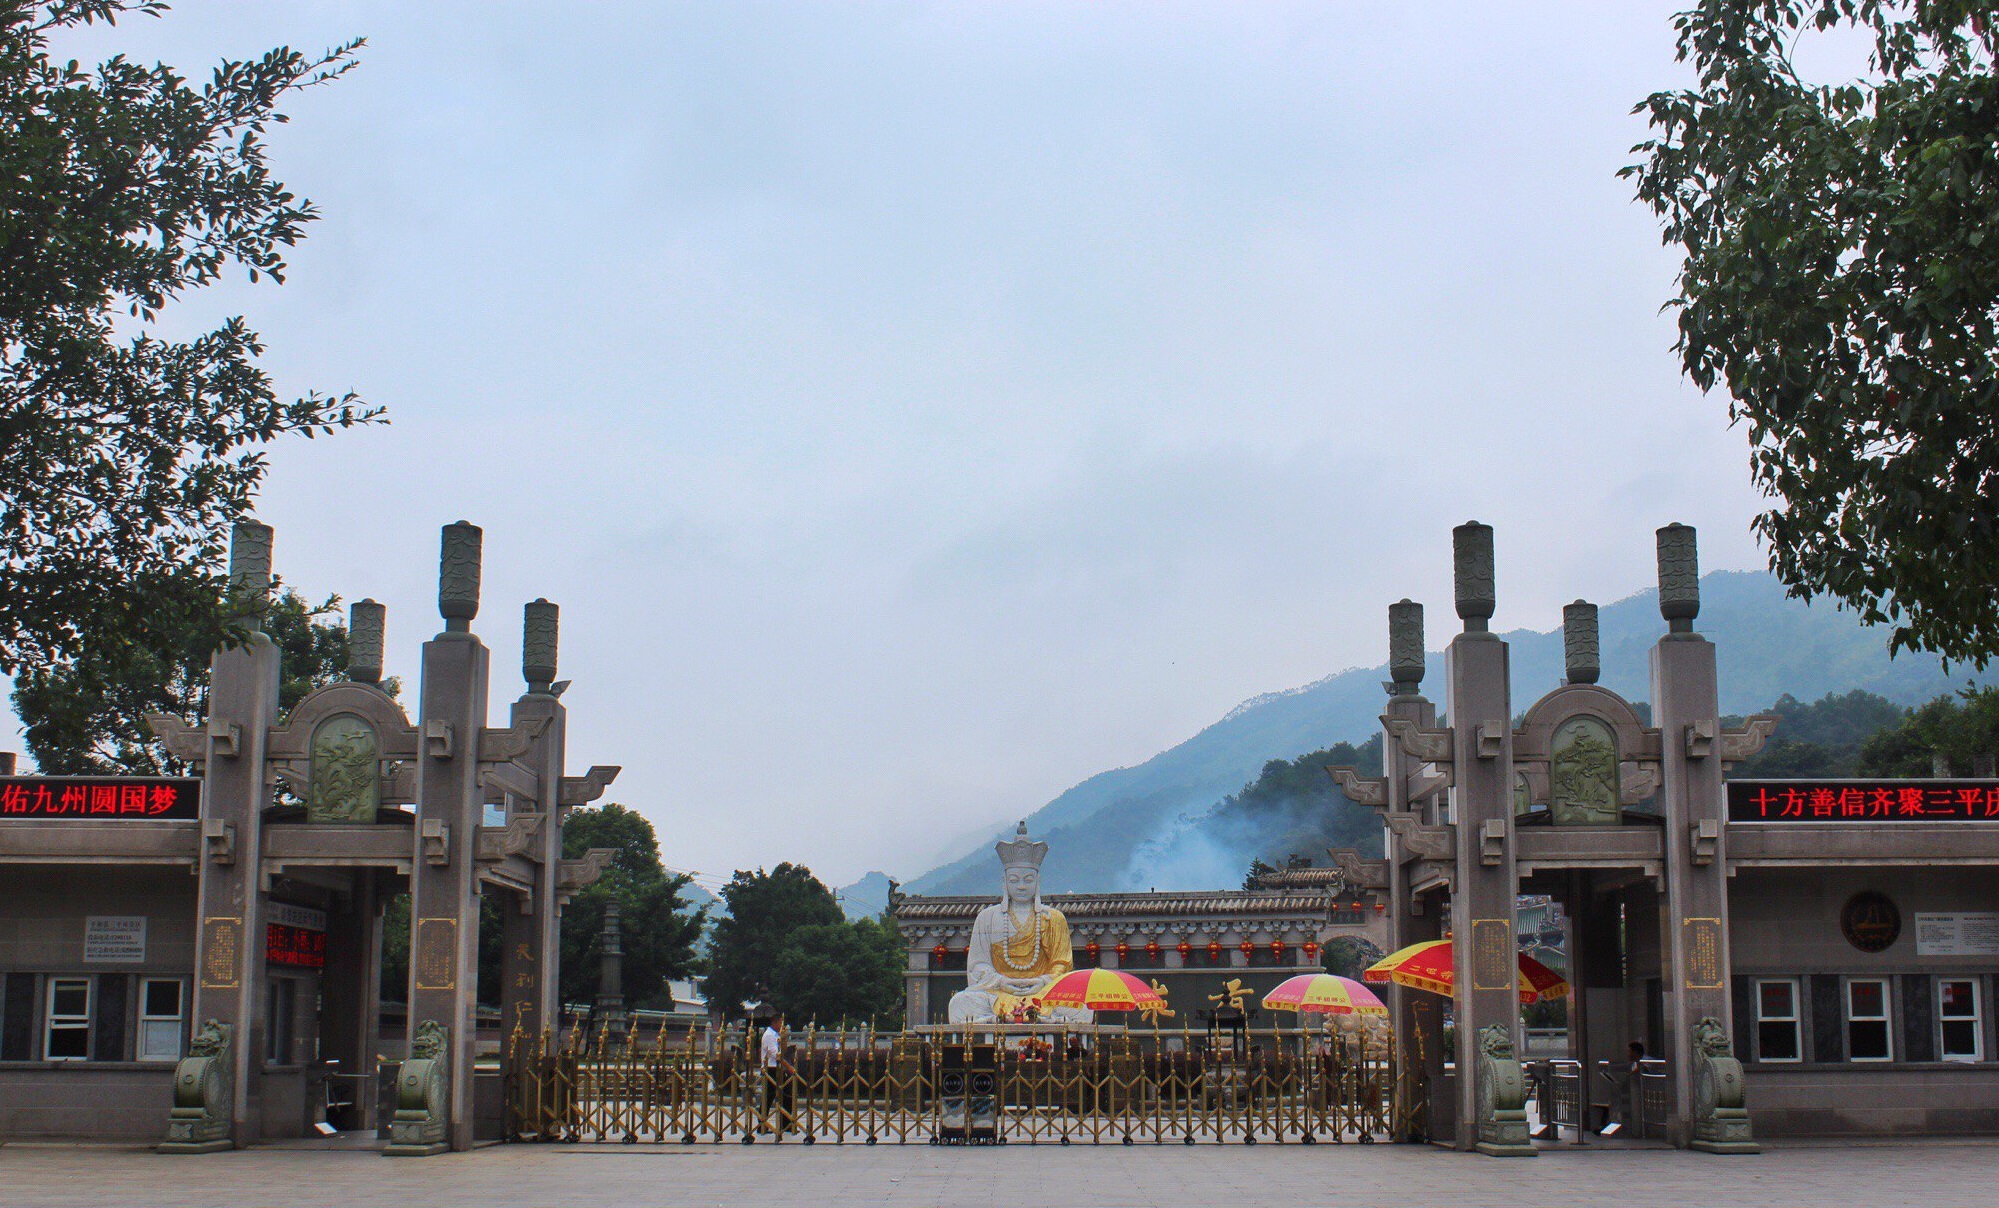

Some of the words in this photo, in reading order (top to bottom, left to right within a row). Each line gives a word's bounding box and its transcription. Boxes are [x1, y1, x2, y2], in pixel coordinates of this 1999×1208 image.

[1, 784, 178, 815] 佑九州圆国梦
